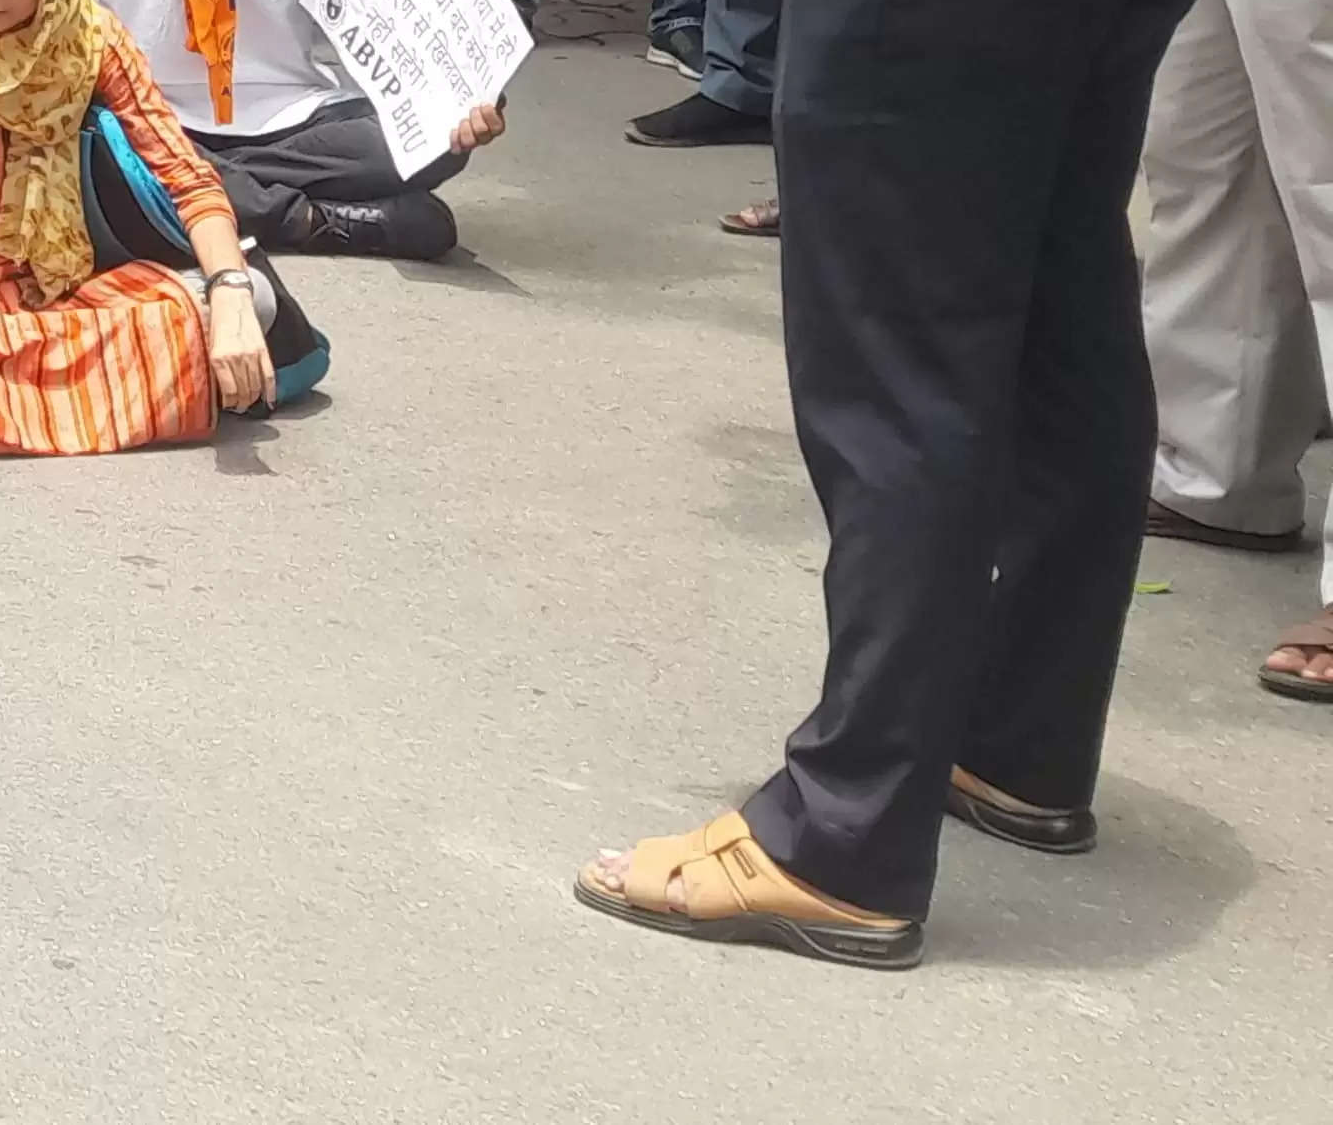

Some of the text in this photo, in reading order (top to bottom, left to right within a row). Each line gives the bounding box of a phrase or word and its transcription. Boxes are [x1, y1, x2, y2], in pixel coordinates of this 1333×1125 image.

[413, 12, 431, 39] से
[339, 25, 428, 154] ABVP BHU
